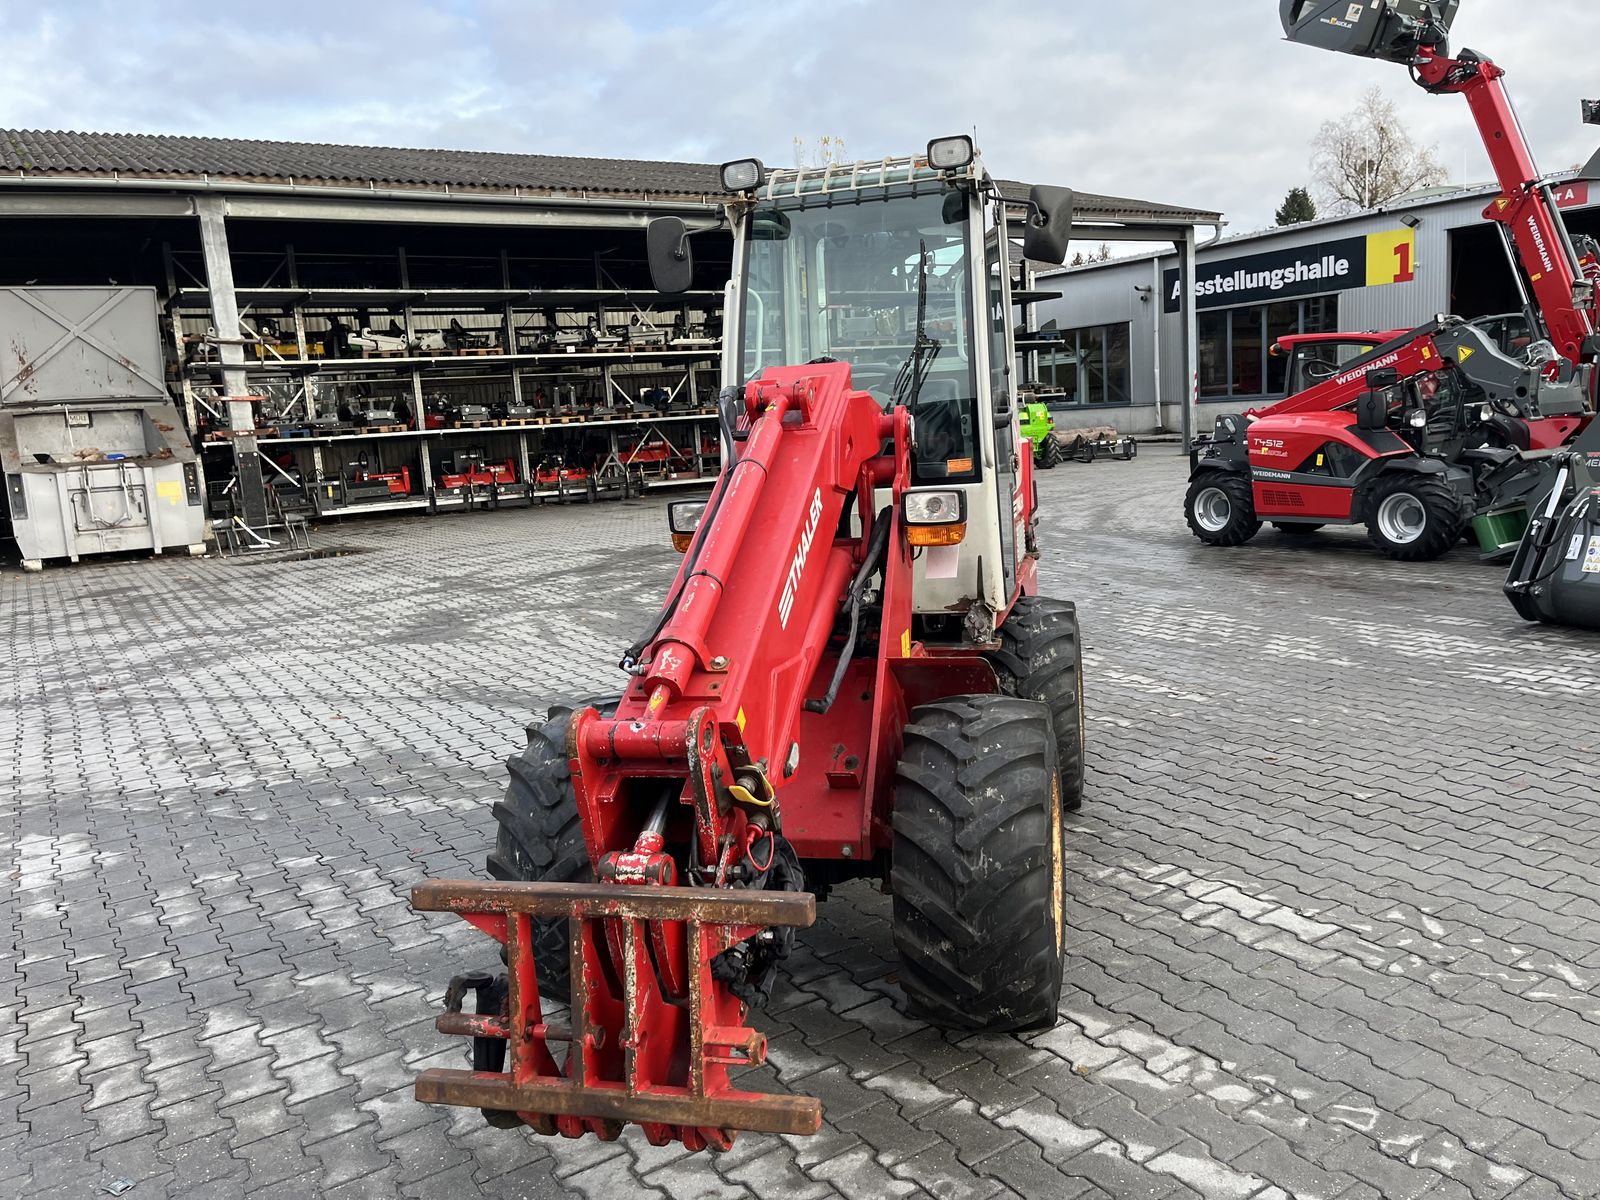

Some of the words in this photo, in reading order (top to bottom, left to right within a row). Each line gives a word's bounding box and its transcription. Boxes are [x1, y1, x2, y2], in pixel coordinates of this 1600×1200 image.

[1564, 188, 1575, 200] A
[1527, 215, 1553, 273] WEIDEMANN
[1171, 255, 1349, 300] Asstellungshalle
[1393, 242, 1414, 283] 1
[1336, 353, 1399, 385] WEIDEMANN
[1253, 438, 1284, 448] T4512
[1252, 470, 1291, 479] WEIDEMANN
[789, 487, 823, 592] THALER
